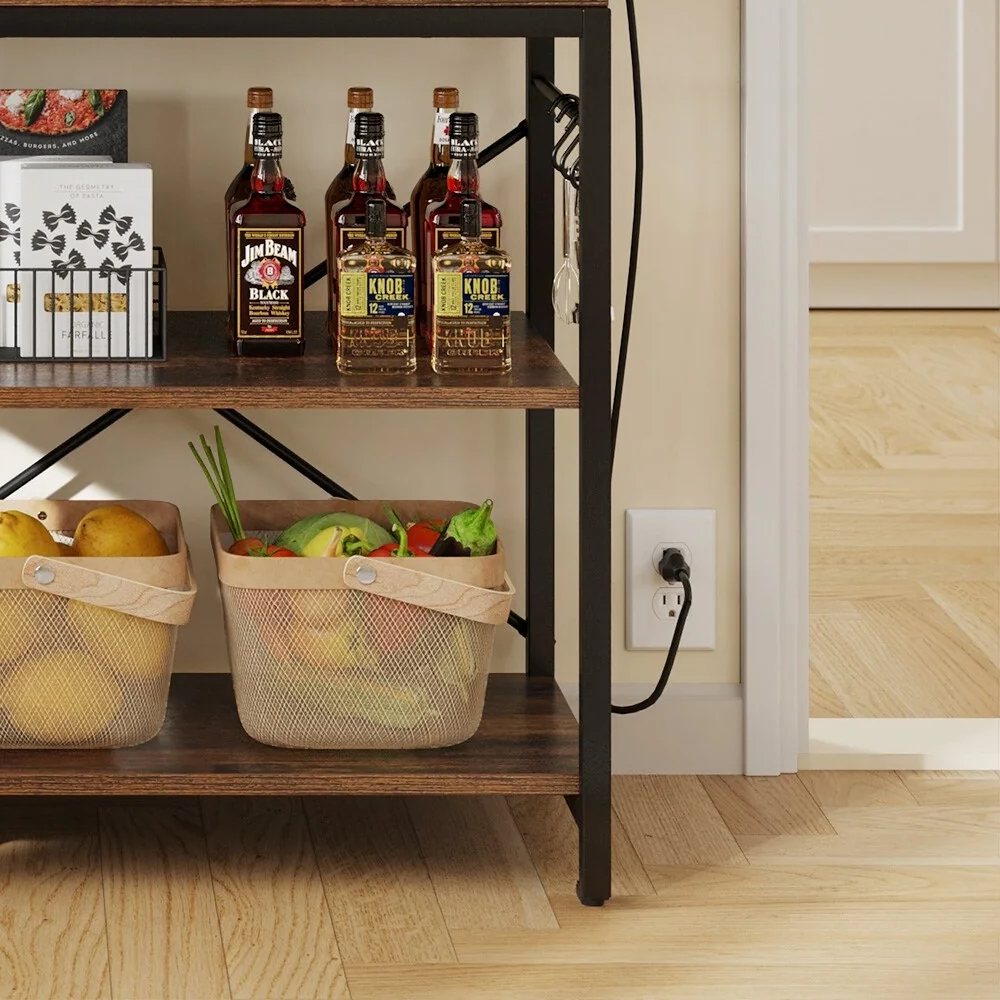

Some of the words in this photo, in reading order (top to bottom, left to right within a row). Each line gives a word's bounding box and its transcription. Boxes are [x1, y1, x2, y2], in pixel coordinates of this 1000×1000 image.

[62, 139, 77, 148] AND
[79, 131, 99, 143] MORE
[241, 244, 264, 268] JIM
[265, 239, 297, 268] BEAM
[249, 288, 289, 300] BLACK
[369, 278, 402, 294] KNOB
[464, 278, 497, 294] KNOB
[369, 302, 378, 314] 12
[464, 302, 473, 314] 12
